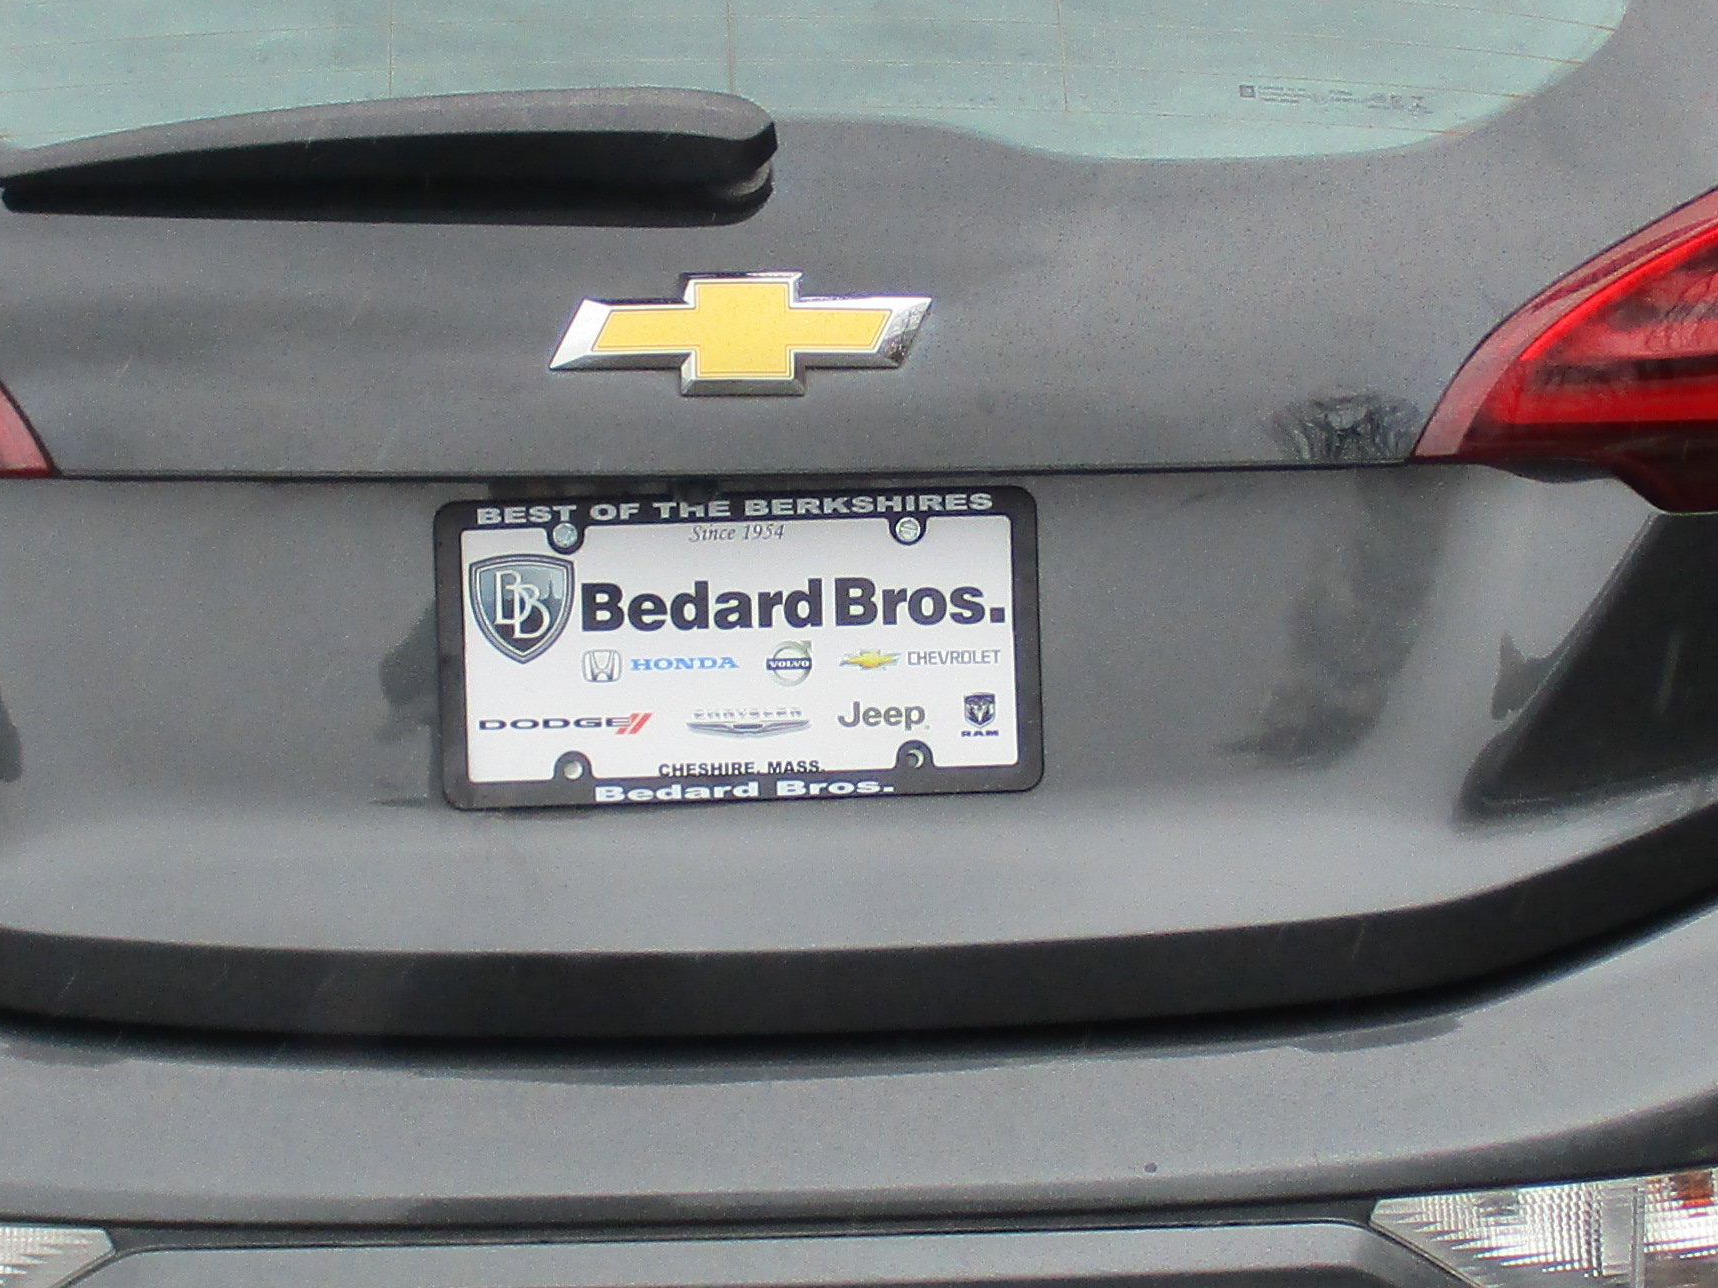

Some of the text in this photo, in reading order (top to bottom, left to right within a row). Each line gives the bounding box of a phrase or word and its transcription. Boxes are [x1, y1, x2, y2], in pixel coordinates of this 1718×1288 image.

[476, 492, 993, 525] BEST OF THE BERKSHIRES
[688, 523, 786, 543] Since 1954
[581, 576, 1006, 632] Bedard Bros.
[630, 657, 740, 672] HONDA
[769, 659, 810, 669] VOLVO
[907, 649, 1001, 666] CHEVROLET
[478, 716, 633, 731] DODGE
[837, 701, 926, 731] Jeep
[767, 760, 826, 775] MASS.
[594, 778, 895, 803] Bedard Bros.
